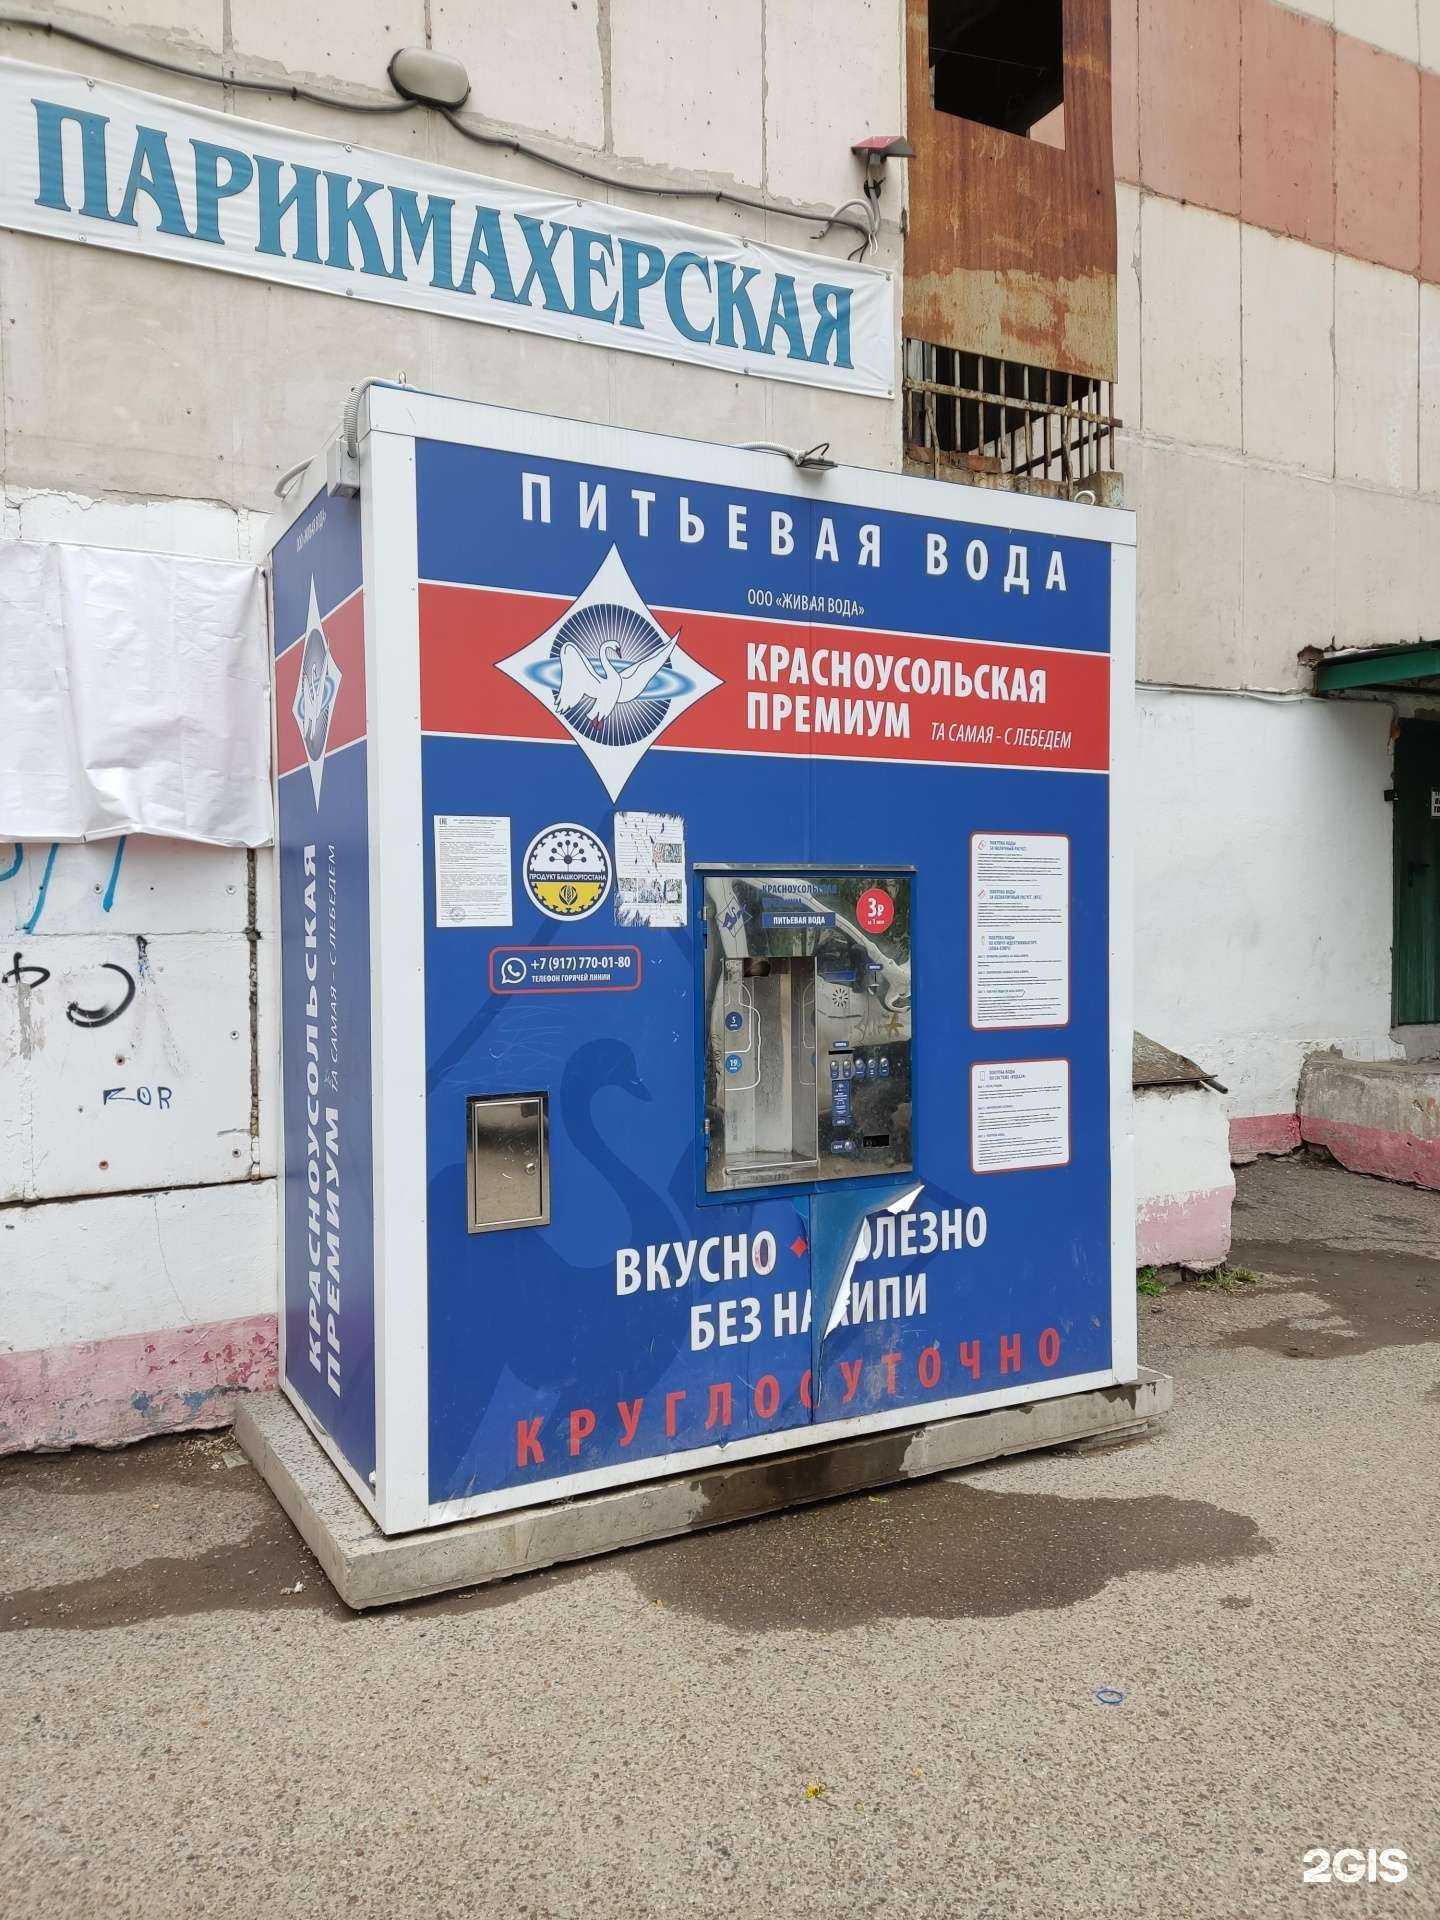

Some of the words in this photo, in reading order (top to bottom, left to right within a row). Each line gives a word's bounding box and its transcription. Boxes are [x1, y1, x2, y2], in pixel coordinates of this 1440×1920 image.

[30, 98, 855, 370] ПАРИКМАХЕРСКАЯ
[521, 472, 881, 568] ПИТЬЕВАЯ
[925, 533, 1068, 595] ВОДА
[748, 589, 773, 607] ООО
[776, 593, 825, 612] «ЖИВАЯ
[828, 598, 865, 618] ВОДА»
[747, 642, 1047, 704] КРАСНОУСОЛЬСКАЯ
[747, 691, 910, 738] ПРЕМИУМ
[931, 721, 945, 741] ТА
[948, 723, 994, 744] САМАЯ
[1004, 727, 1014, 746] С
[1013, 729, 1072, 749] ЛЕБЕДЕМ
[328, 844, 337, 950] ЛЕБЕДЕМ
[529, 873, 556, 881] ПРОДУКТ
[557, 873, 607, 881] БАШКОРТОСТАНА
[773, 916, 807, 925] ПИТЬЕВАЯ
[808, 915, 826, 925] ВОДА
[530, 957, 547, 970] +7
[548, 956, 577, 971] (917)
[579, 956, 631, 969] 770-01-80
[531, 974, 560, 983] ТЕЛЕФОН
[561, 972, 588, 982] ГОРЯЧЕЙ
[328, 985, 338, 1064] САМАЯ
[304, 844, 322, 1374] КРАСНОУСОЛЬСКАЯ
[325, 1106, 341, 1399] ПРЕМИУМ
[617, 1230, 776, 1296] ВКУСНО
[691, 1297, 761, 1351] БЕЗ
[516, 1328, 1061, 1467] КРУГЛОСУТОЧНО
